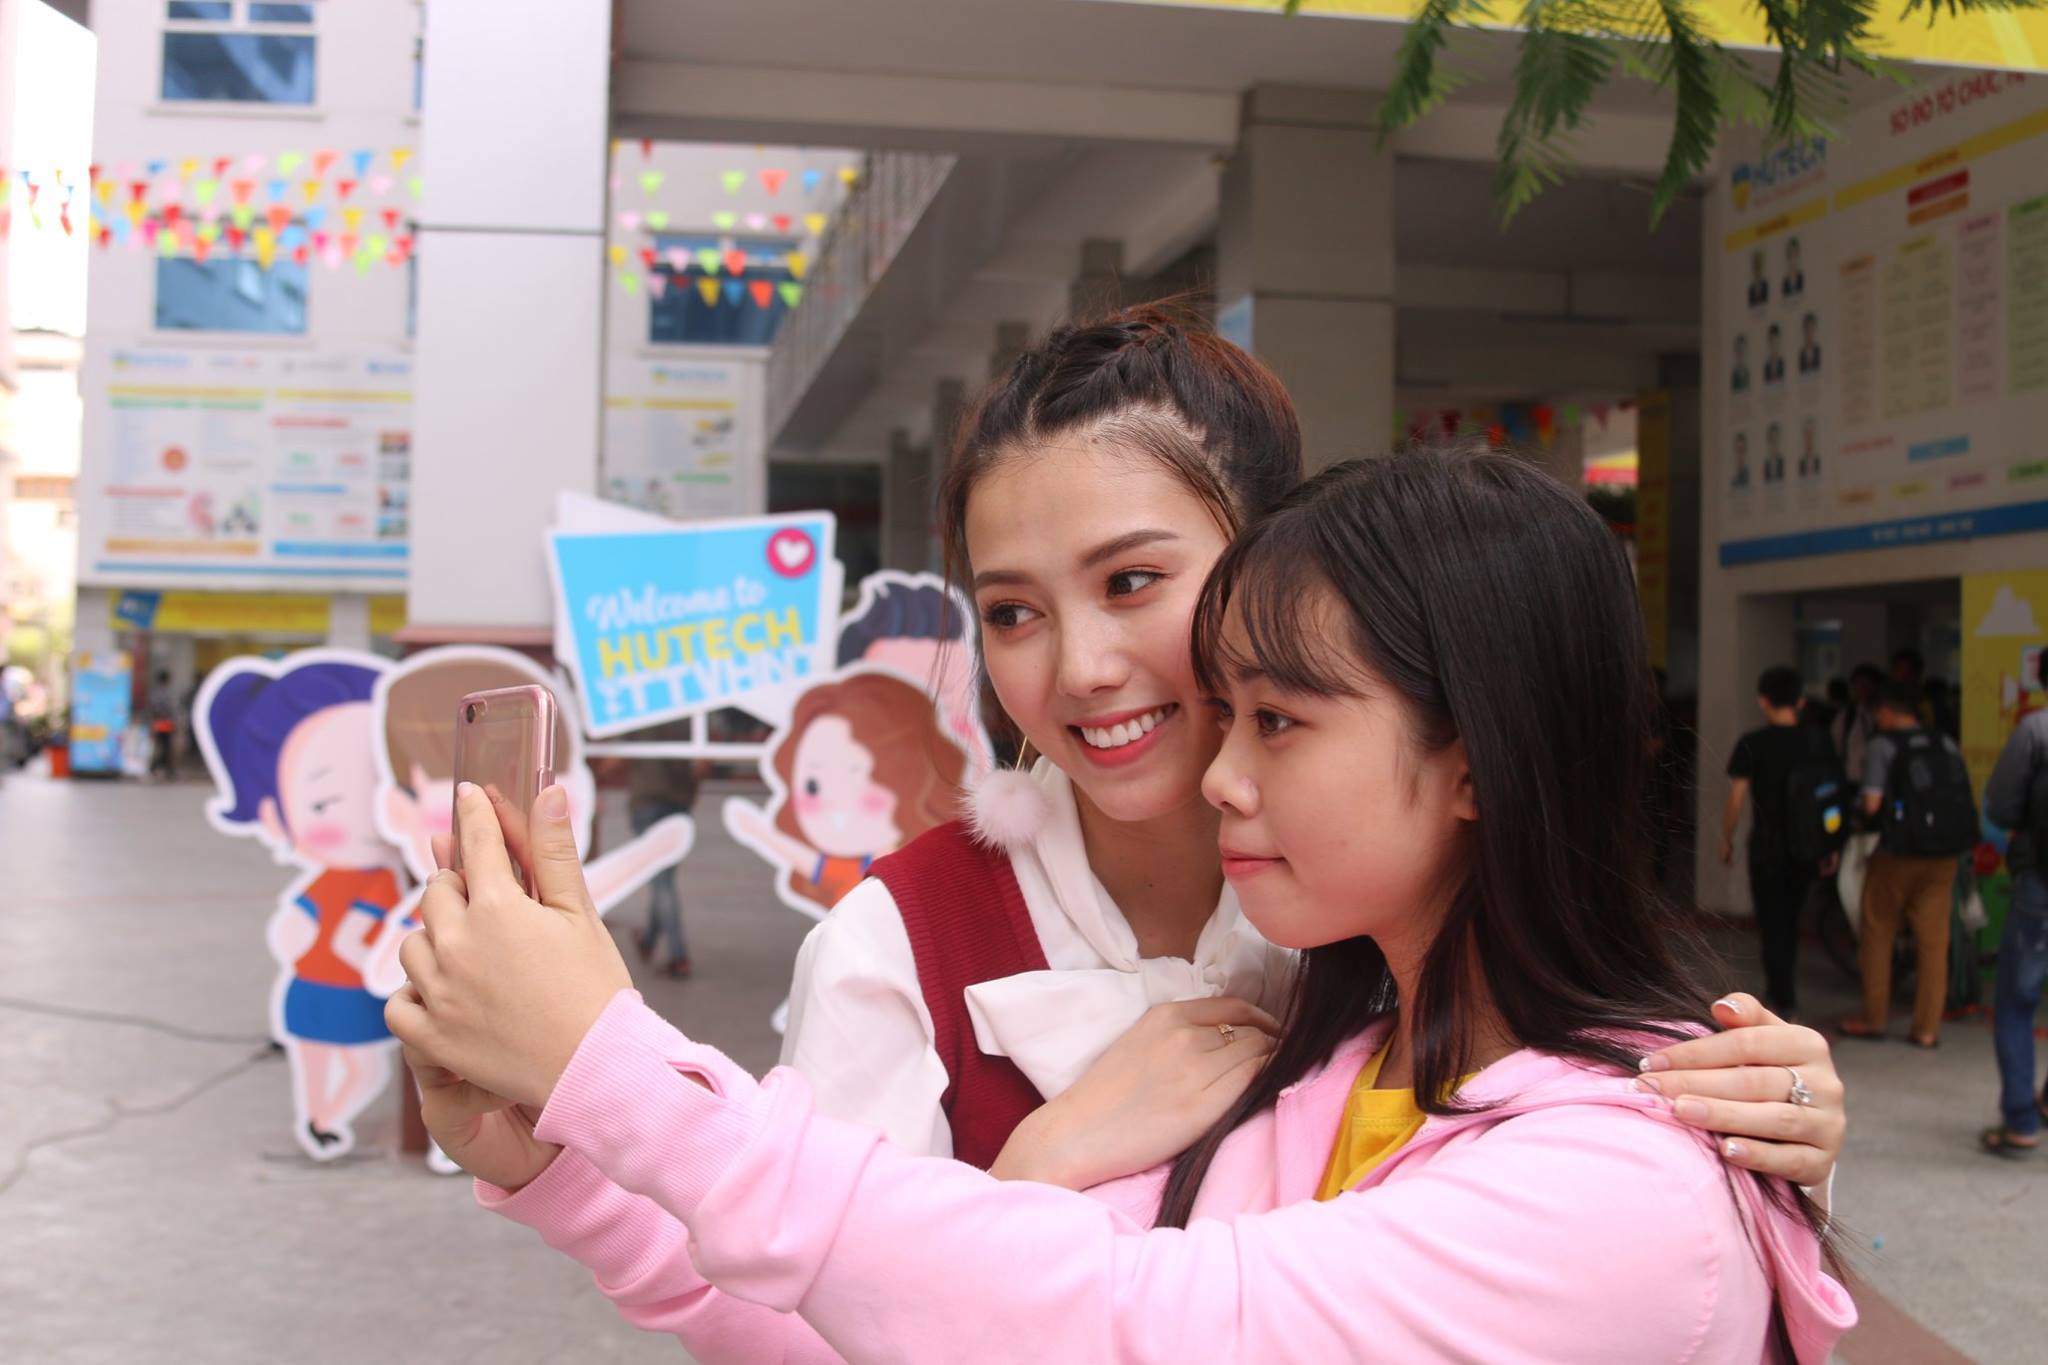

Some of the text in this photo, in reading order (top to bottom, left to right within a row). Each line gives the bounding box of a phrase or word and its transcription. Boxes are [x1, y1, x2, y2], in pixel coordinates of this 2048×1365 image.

[586, 576, 768, 631] Welcome to
[597, 606, 804, 679] HUTECH
